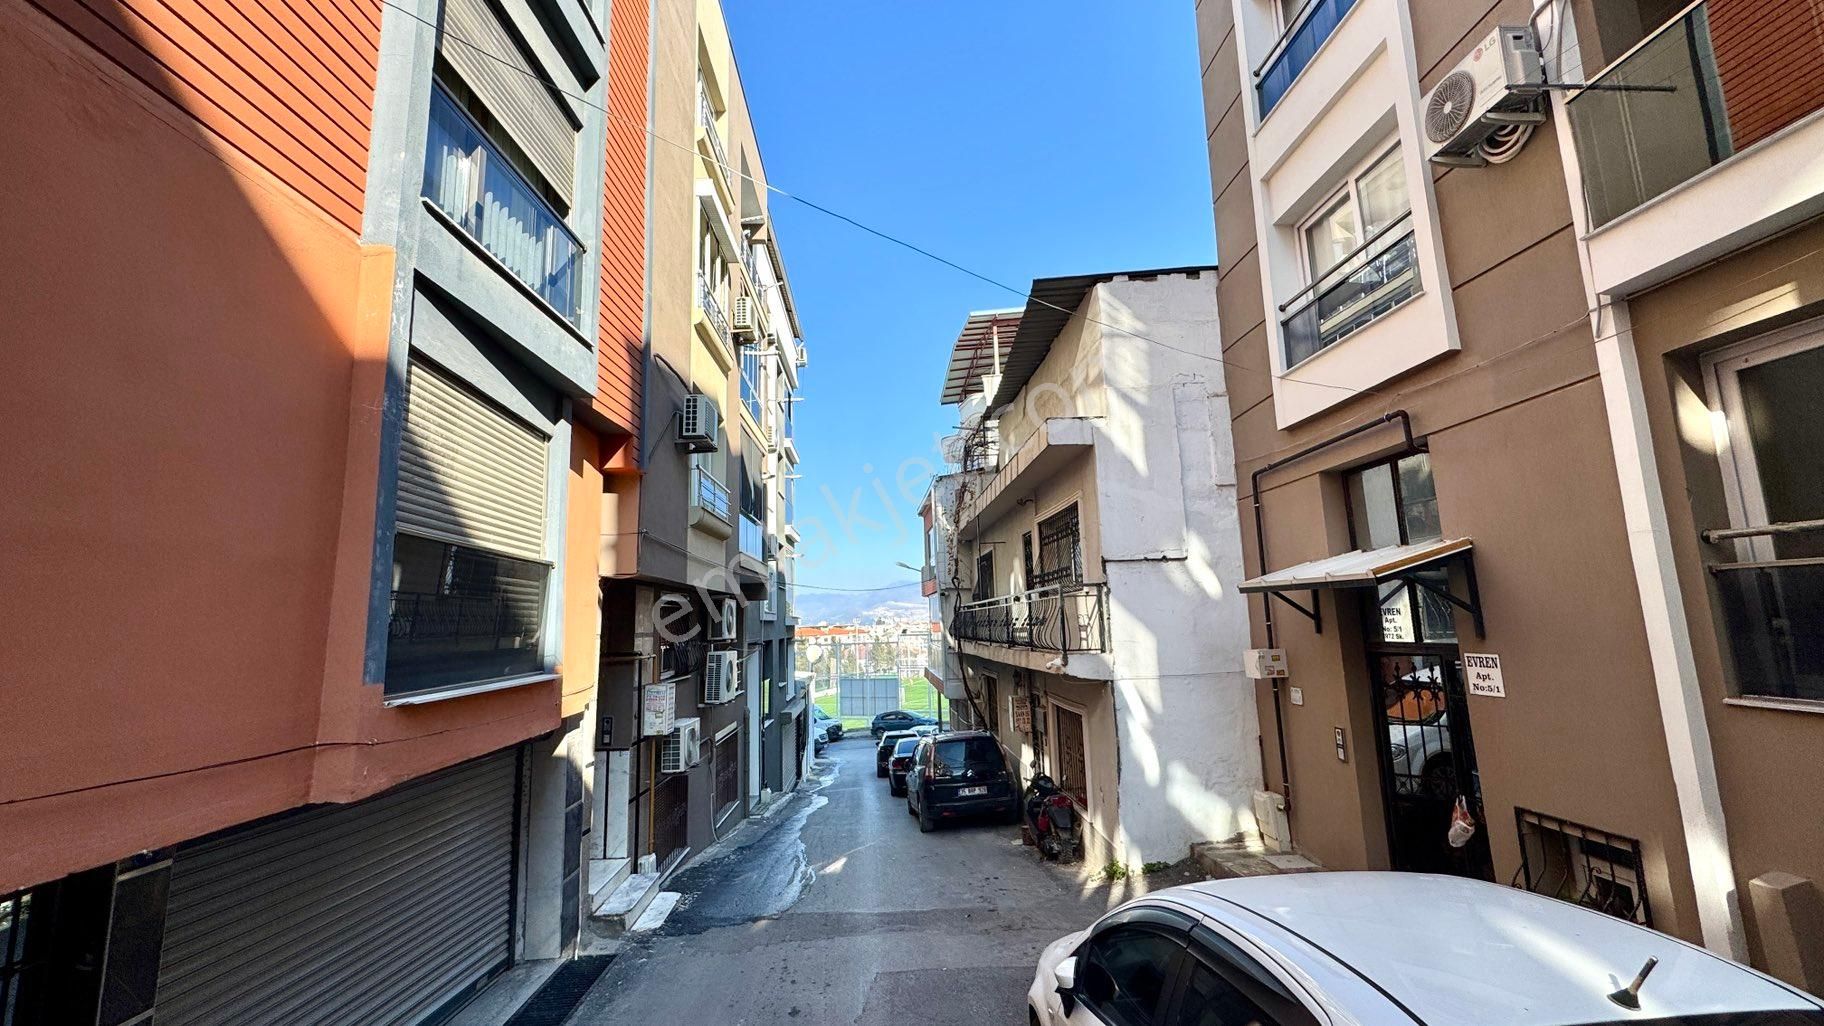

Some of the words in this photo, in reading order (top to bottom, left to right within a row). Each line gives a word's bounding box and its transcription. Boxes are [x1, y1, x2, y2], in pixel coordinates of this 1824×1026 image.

[1484, 36, 1496, 51] LG
[1465, 655, 1498, 669] EVREN
[1476, 672, 1494, 681] Apt.
[1472, 683, 1501, 693] No:5/1
